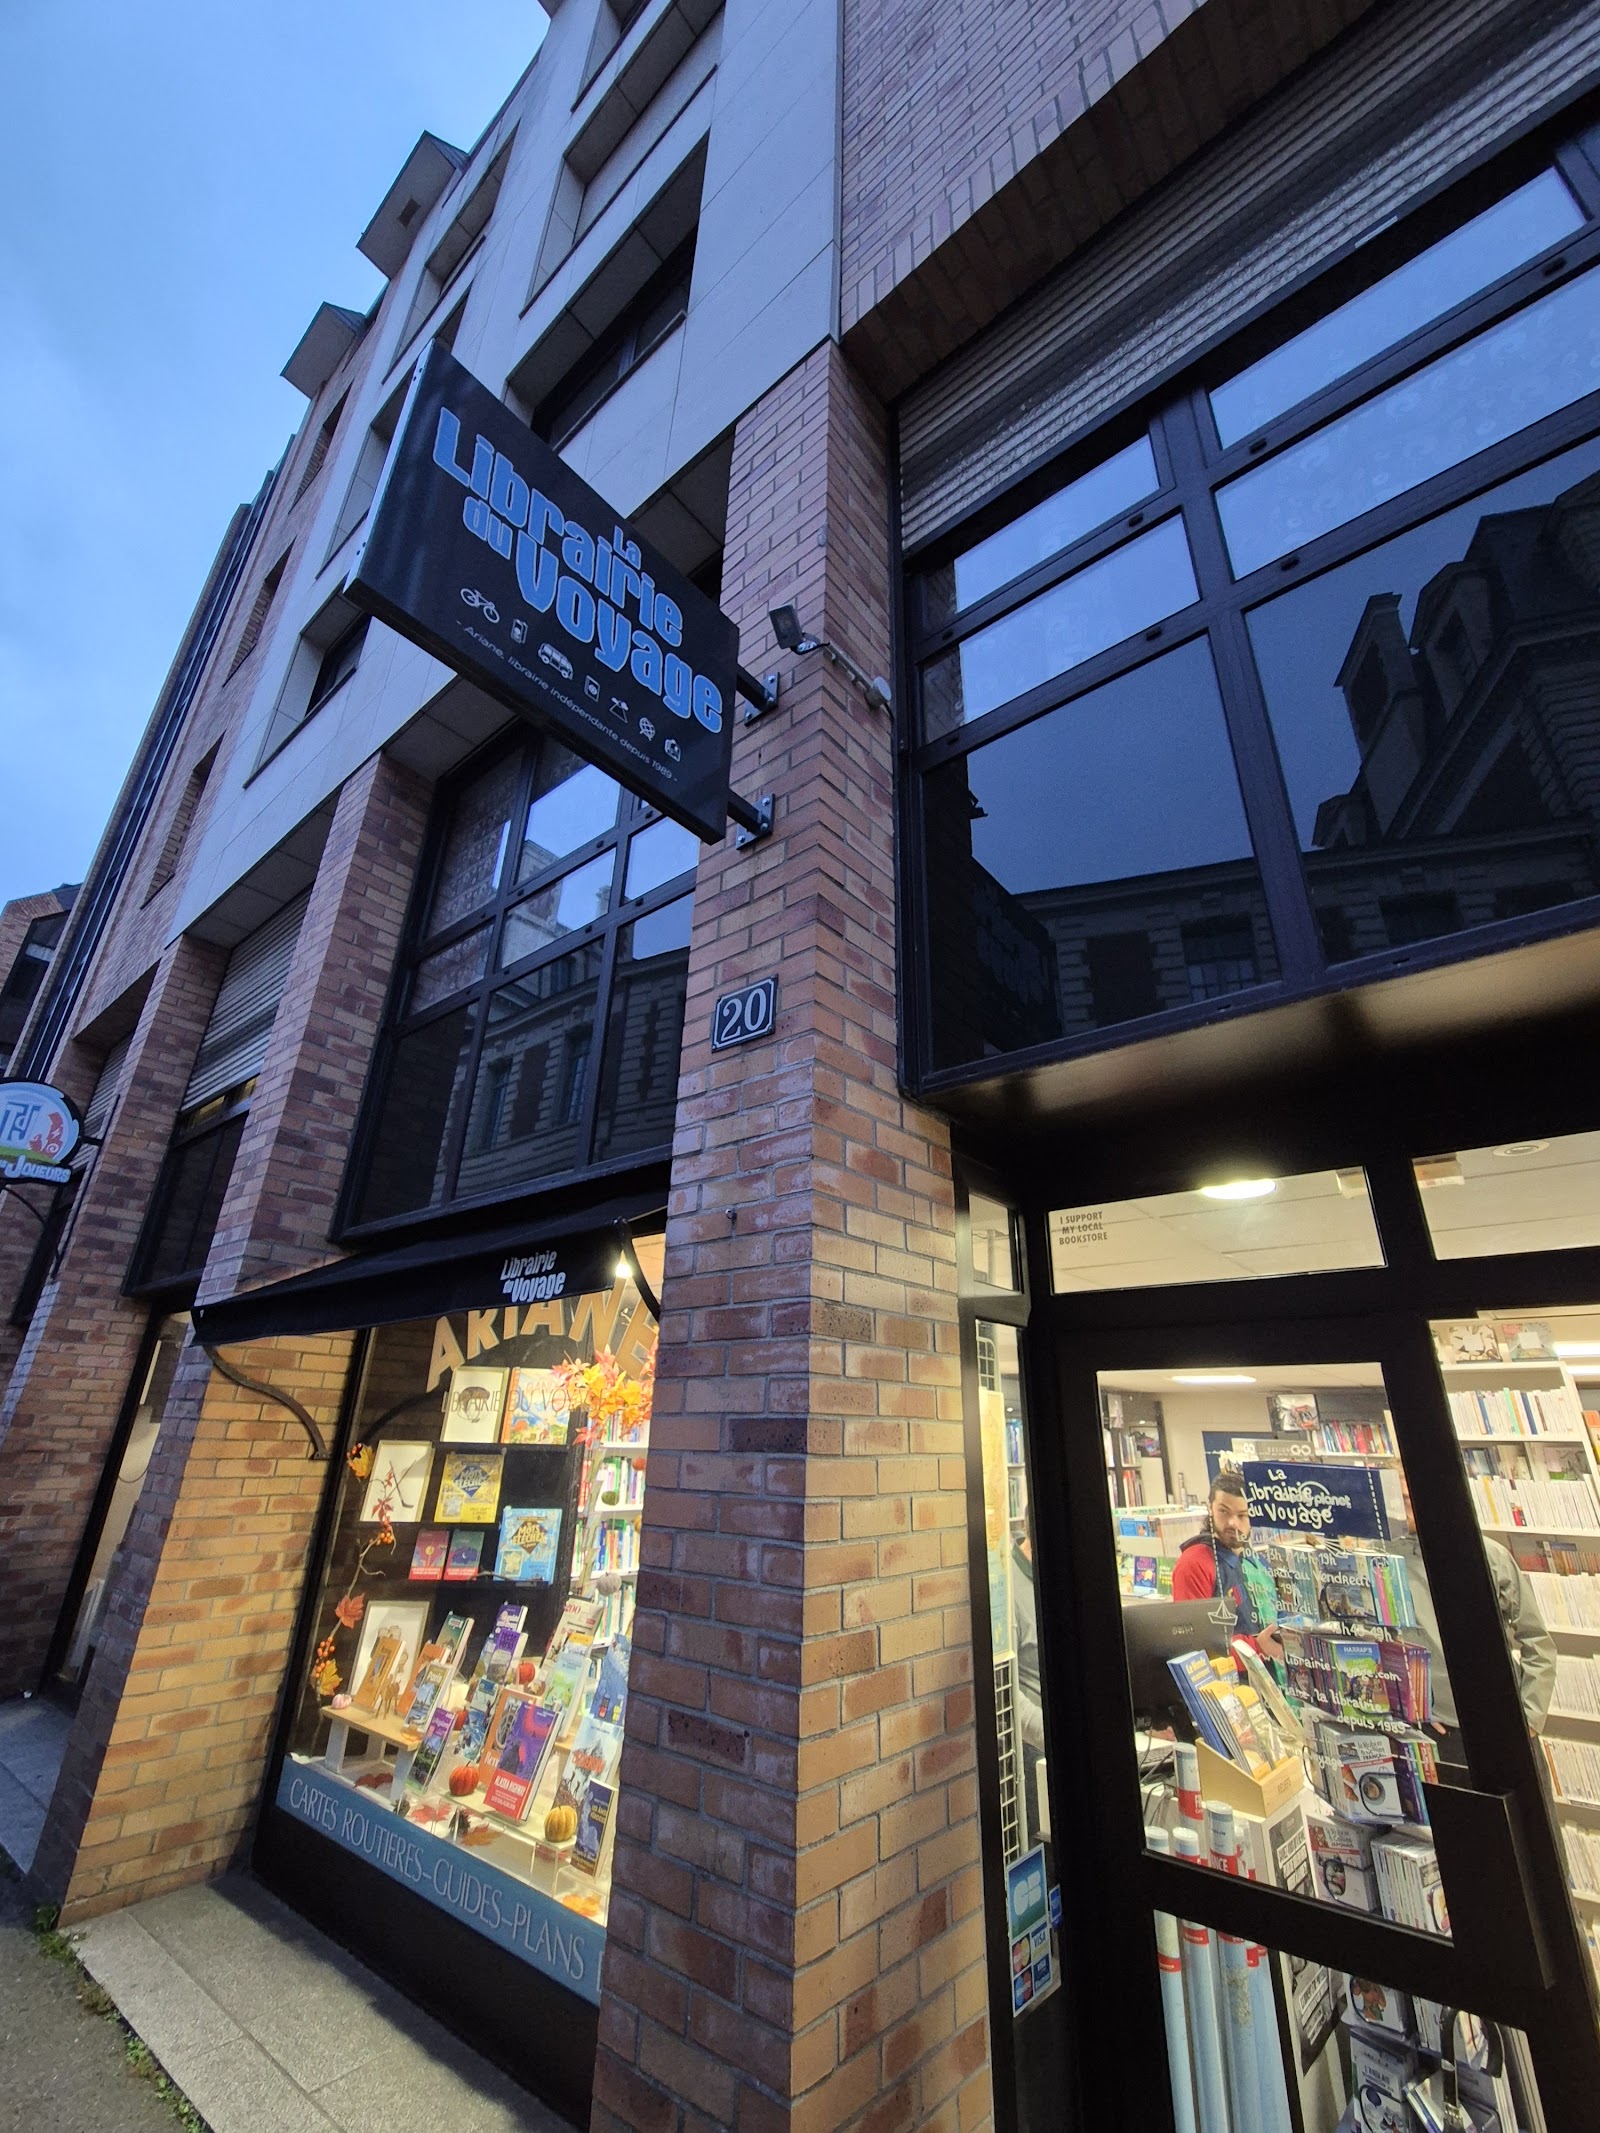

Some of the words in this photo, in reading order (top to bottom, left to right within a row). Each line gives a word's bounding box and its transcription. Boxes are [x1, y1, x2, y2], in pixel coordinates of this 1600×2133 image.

[433, 407, 683, 647] Librairie
[613, 525, 642, 570] La
[463, 496, 513, 560] du
[515, 530, 723, 733] Voyage
[508, 656, 549, 690] librairie
[550, 687, 619, 741] indépendante
[619, 736, 650, 764] depuis
[651, 760, 672, 779] 1989
[721, 988, 767, 1041] 20
[1062, 1225, 1075, 1234] MY
[1078, 1222, 1103, 1232] LOCAL
[1066, 1211, 1102, 1224] SUPPORT
[1059, 1232, 1108, 1245] BOOKSTORE
[500, 1250, 557, 1281] Librairie
[511, 1272, 566, 1303] Voyage
[1267, 1468, 1288, 1481] La
[1248, 1503, 1264, 1518] du
[1264, 1502, 1334, 1530] Voyage
[289, 1777, 339, 1831] CARTES
